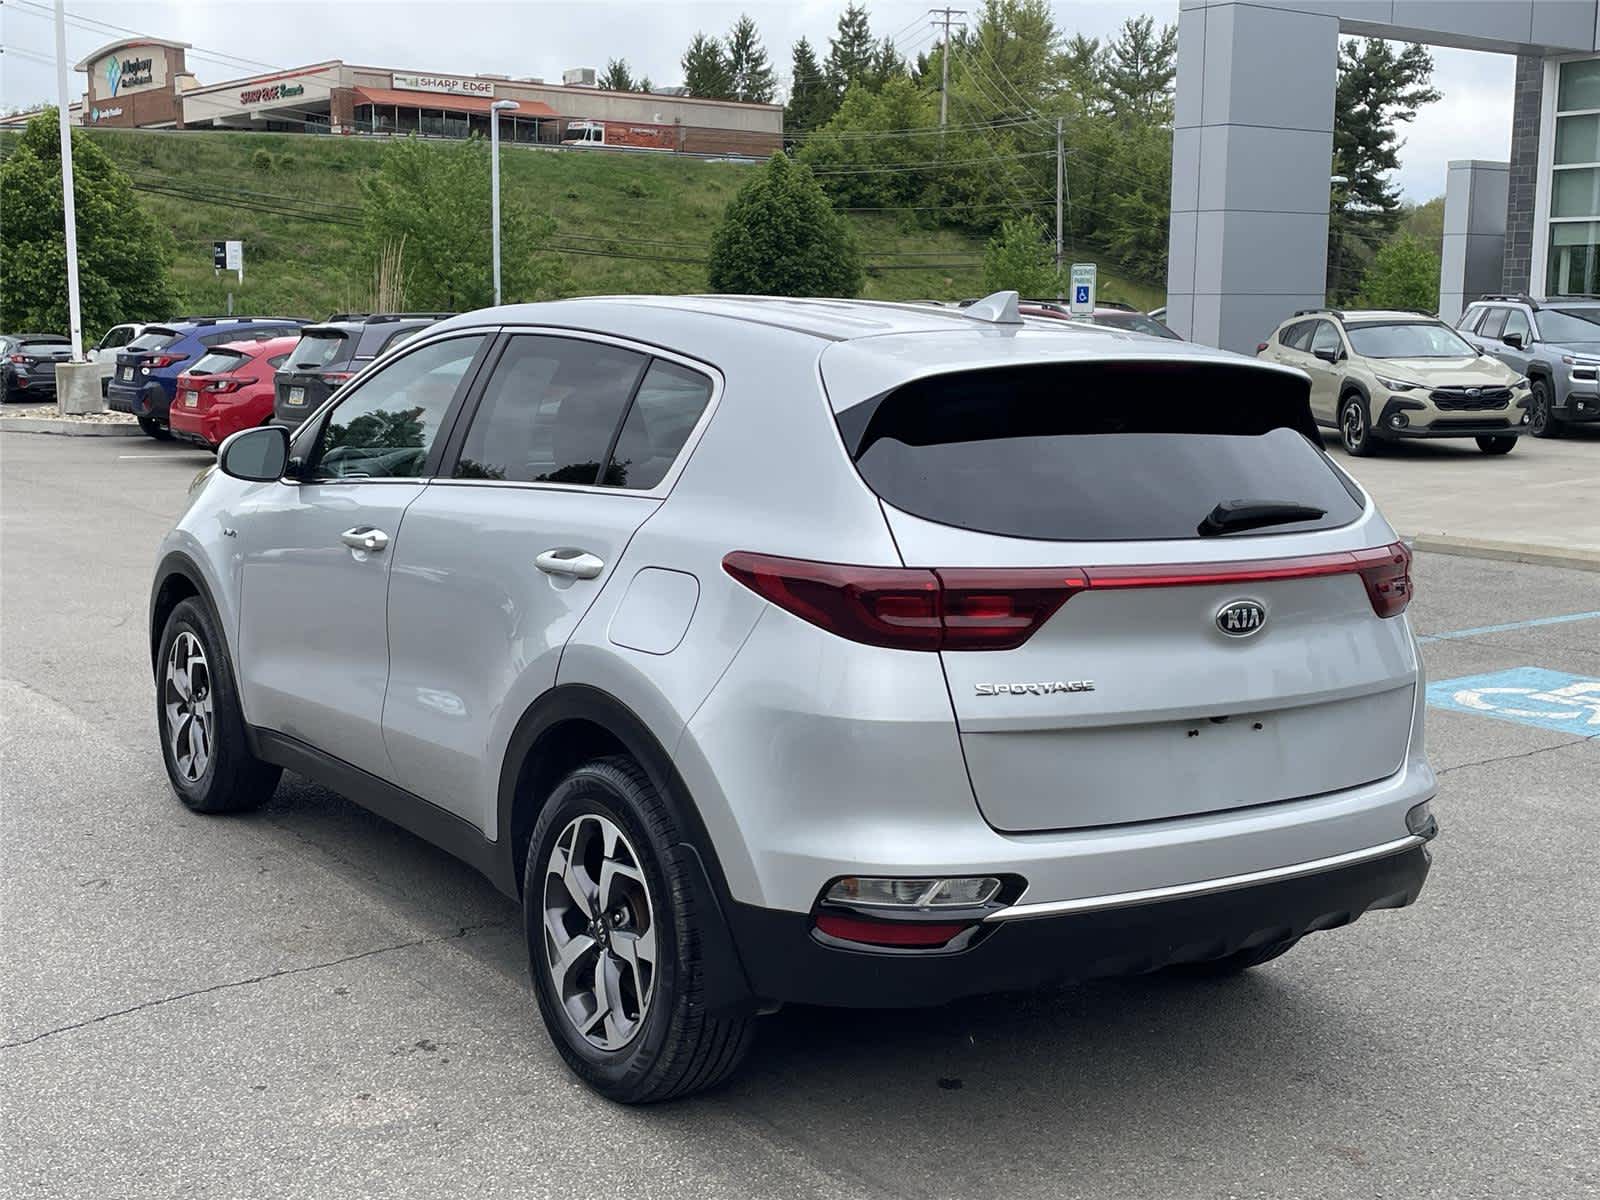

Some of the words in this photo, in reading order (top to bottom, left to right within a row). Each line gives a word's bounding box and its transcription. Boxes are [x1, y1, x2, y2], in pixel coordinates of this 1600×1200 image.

[420, 78, 458, 88] SHARP
[462, 81, 492, 93] EDGE
[1227, 608, 1260, 629] KIA
[975, 680, 1096, 697] SPORTAGE
